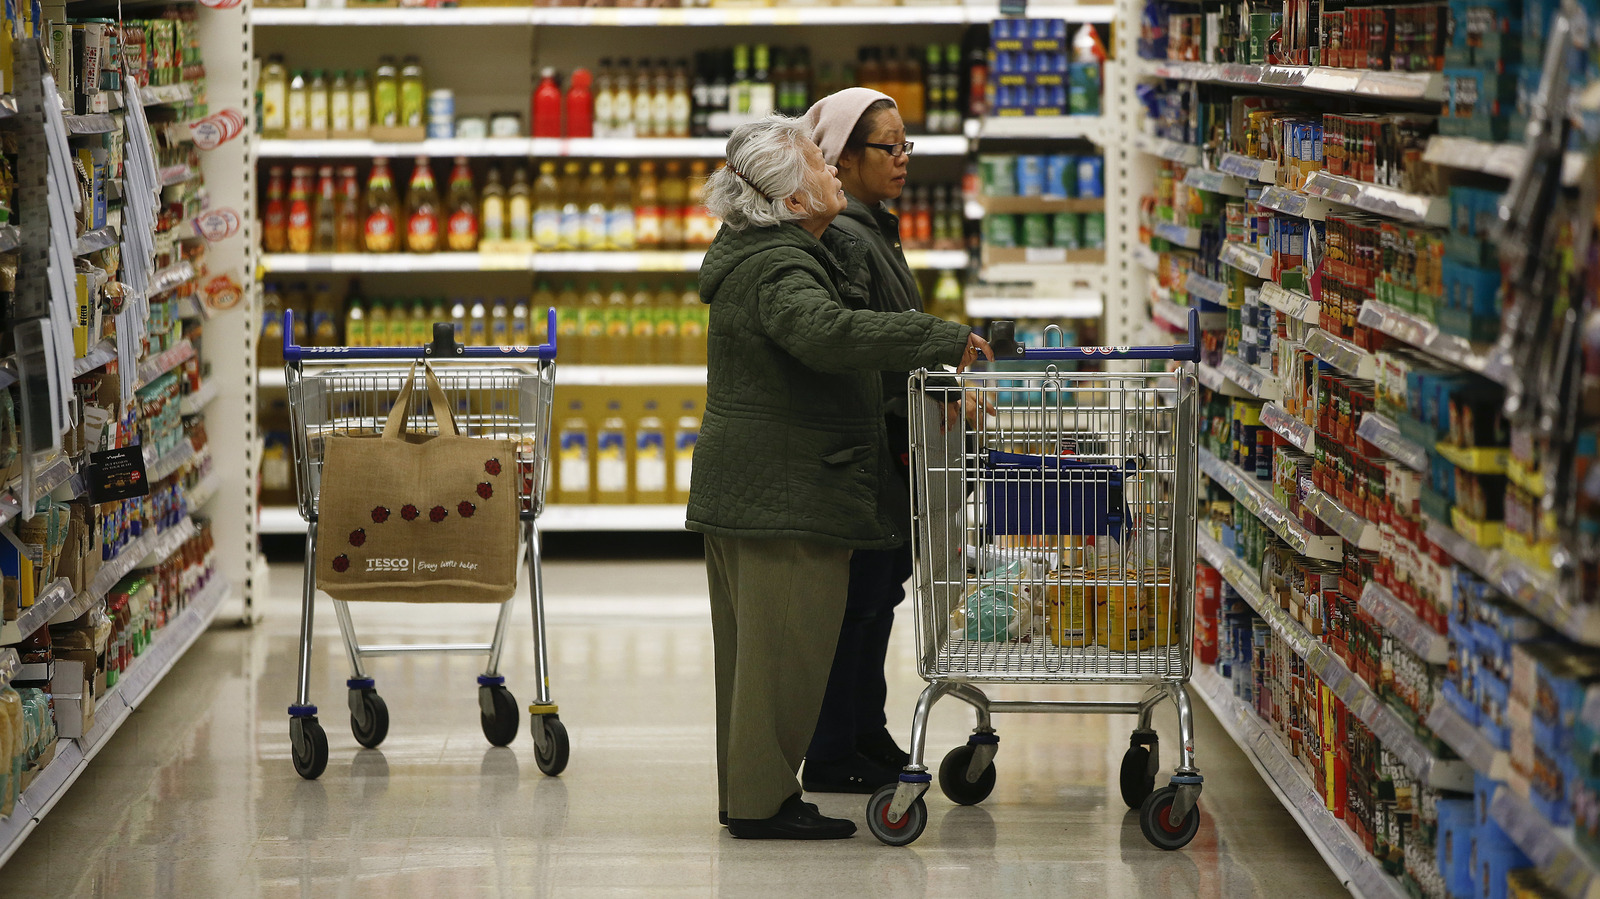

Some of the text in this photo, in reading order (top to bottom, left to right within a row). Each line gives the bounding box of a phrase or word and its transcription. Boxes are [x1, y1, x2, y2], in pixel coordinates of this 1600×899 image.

[366, 558, 409, 568] TESCO
[418, 561, 438, 572] Every
[459, 561, 478, 571] helps
